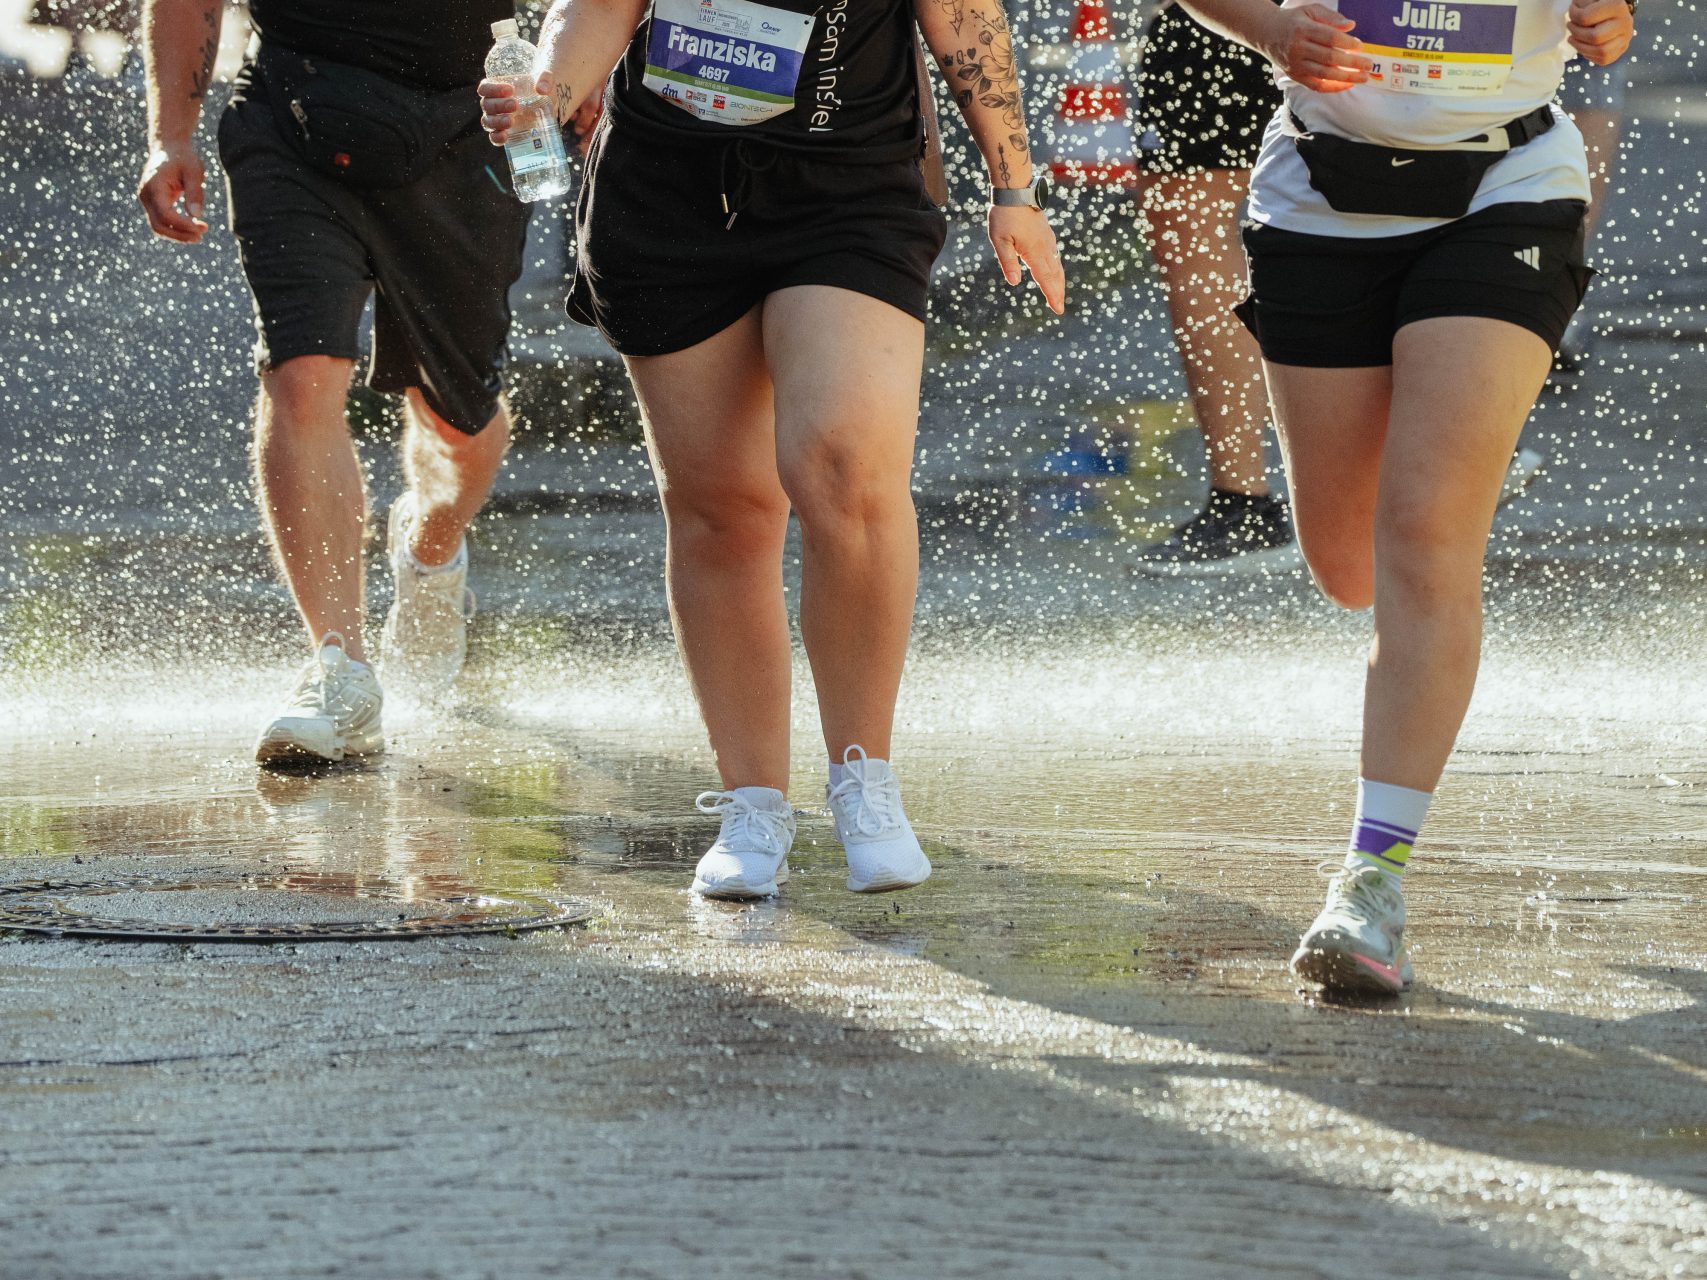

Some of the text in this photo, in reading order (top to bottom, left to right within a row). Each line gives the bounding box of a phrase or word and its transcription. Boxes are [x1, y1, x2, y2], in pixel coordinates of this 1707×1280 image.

[699, 14, 716, 23] LAUF
[1392, 1, 1461, 32] Julia
[667, 24, 777, 73] Franziska
[1406, 34, 1444, 51] 5774
[698, 64, 730, 83] 4697
[661, 83, 679, 99] dm
